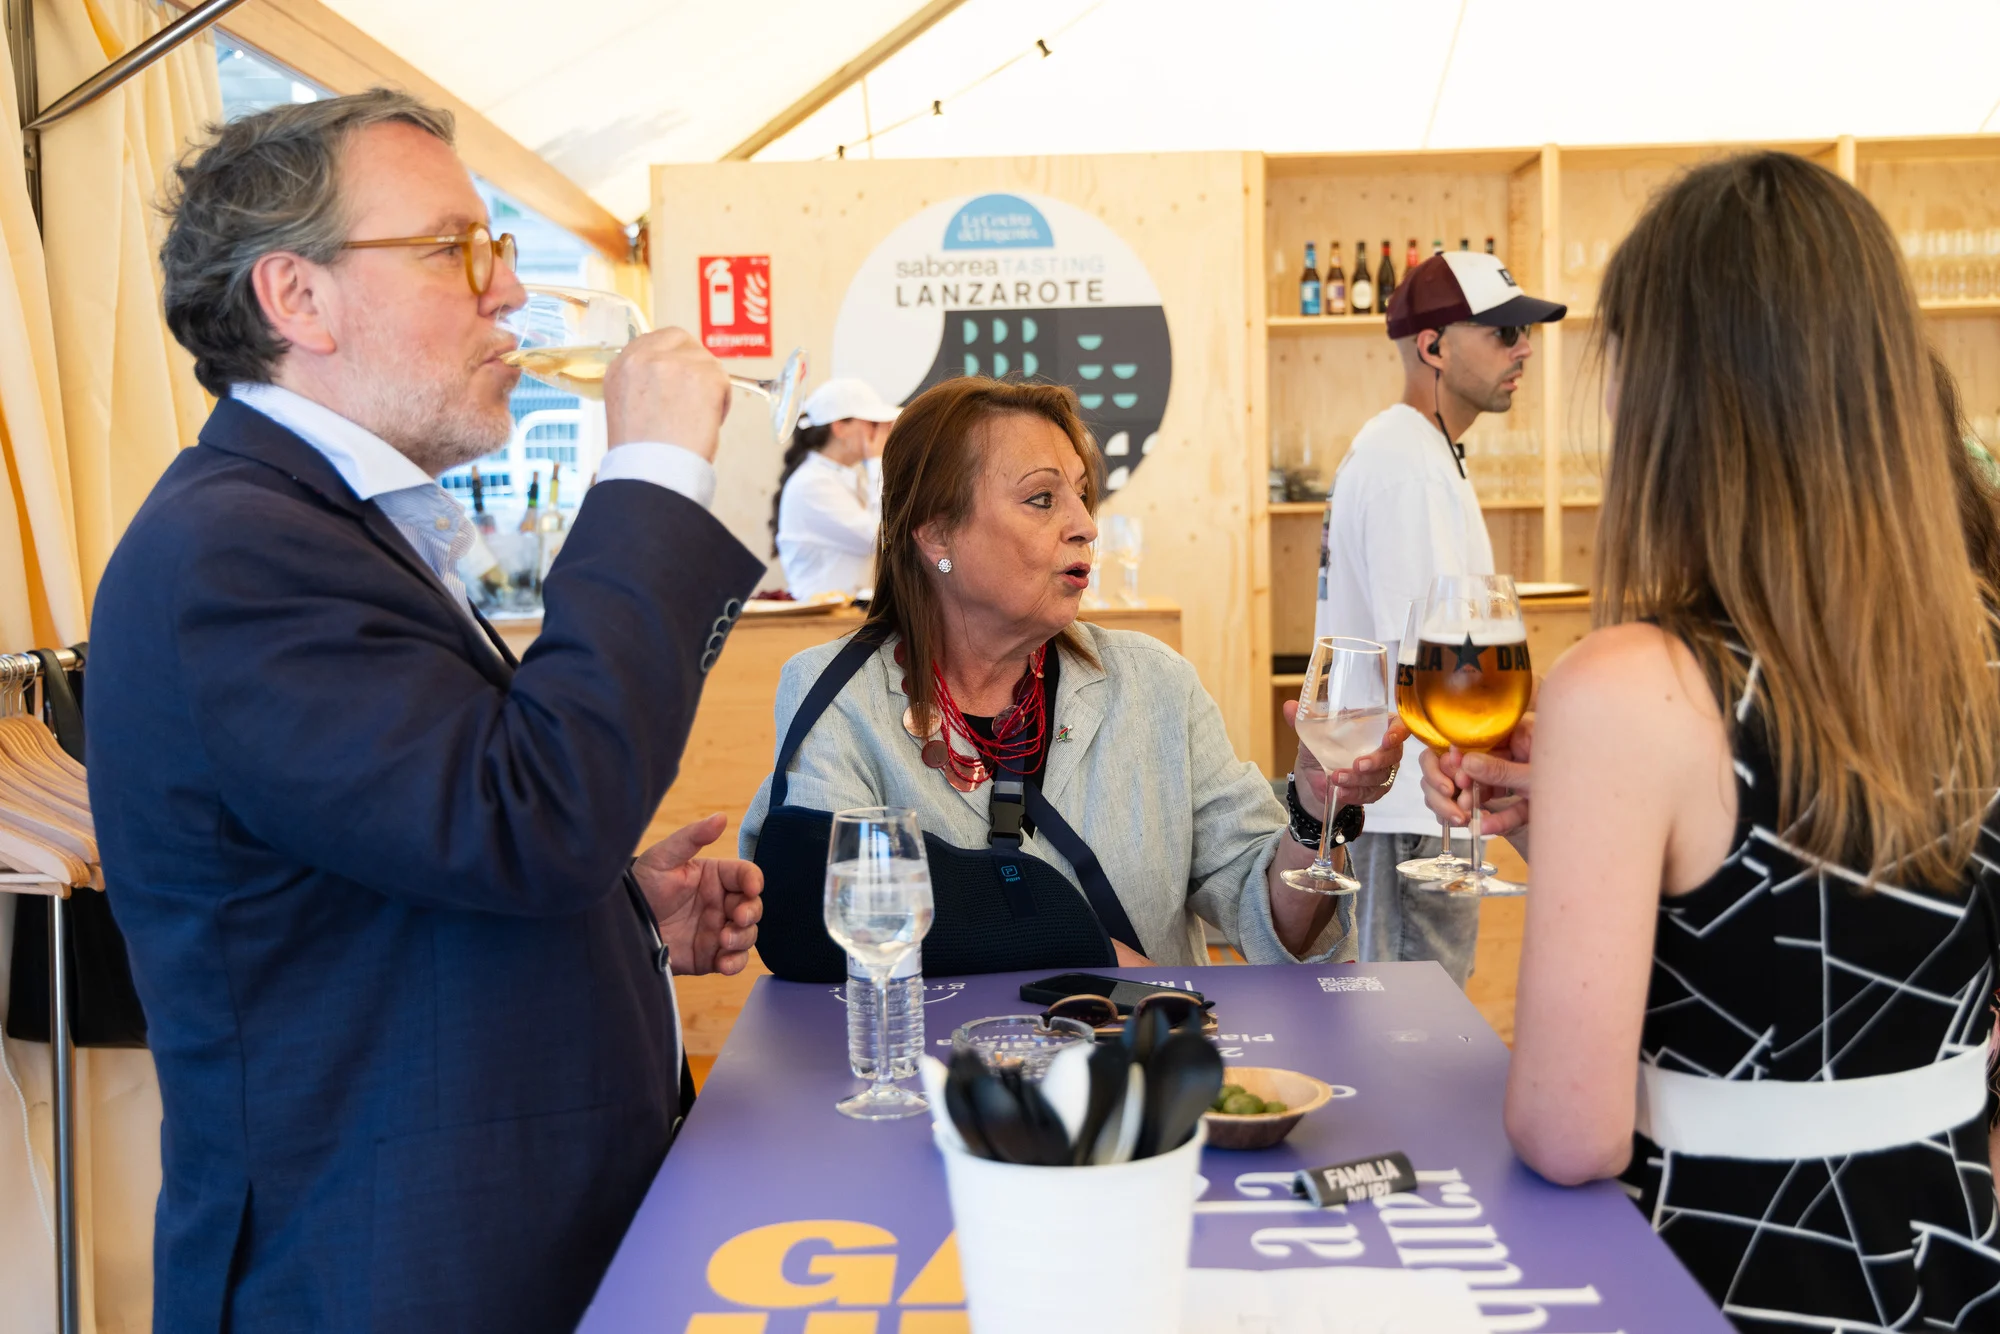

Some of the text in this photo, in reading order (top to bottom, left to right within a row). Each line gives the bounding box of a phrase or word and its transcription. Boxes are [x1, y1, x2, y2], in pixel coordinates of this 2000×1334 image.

[896, 254, 1106, 278] saborea TASTING
[896, 280, 1105, 307] LANZAROTE
[1323, 1159, 1401, 1190] FAMILIA
